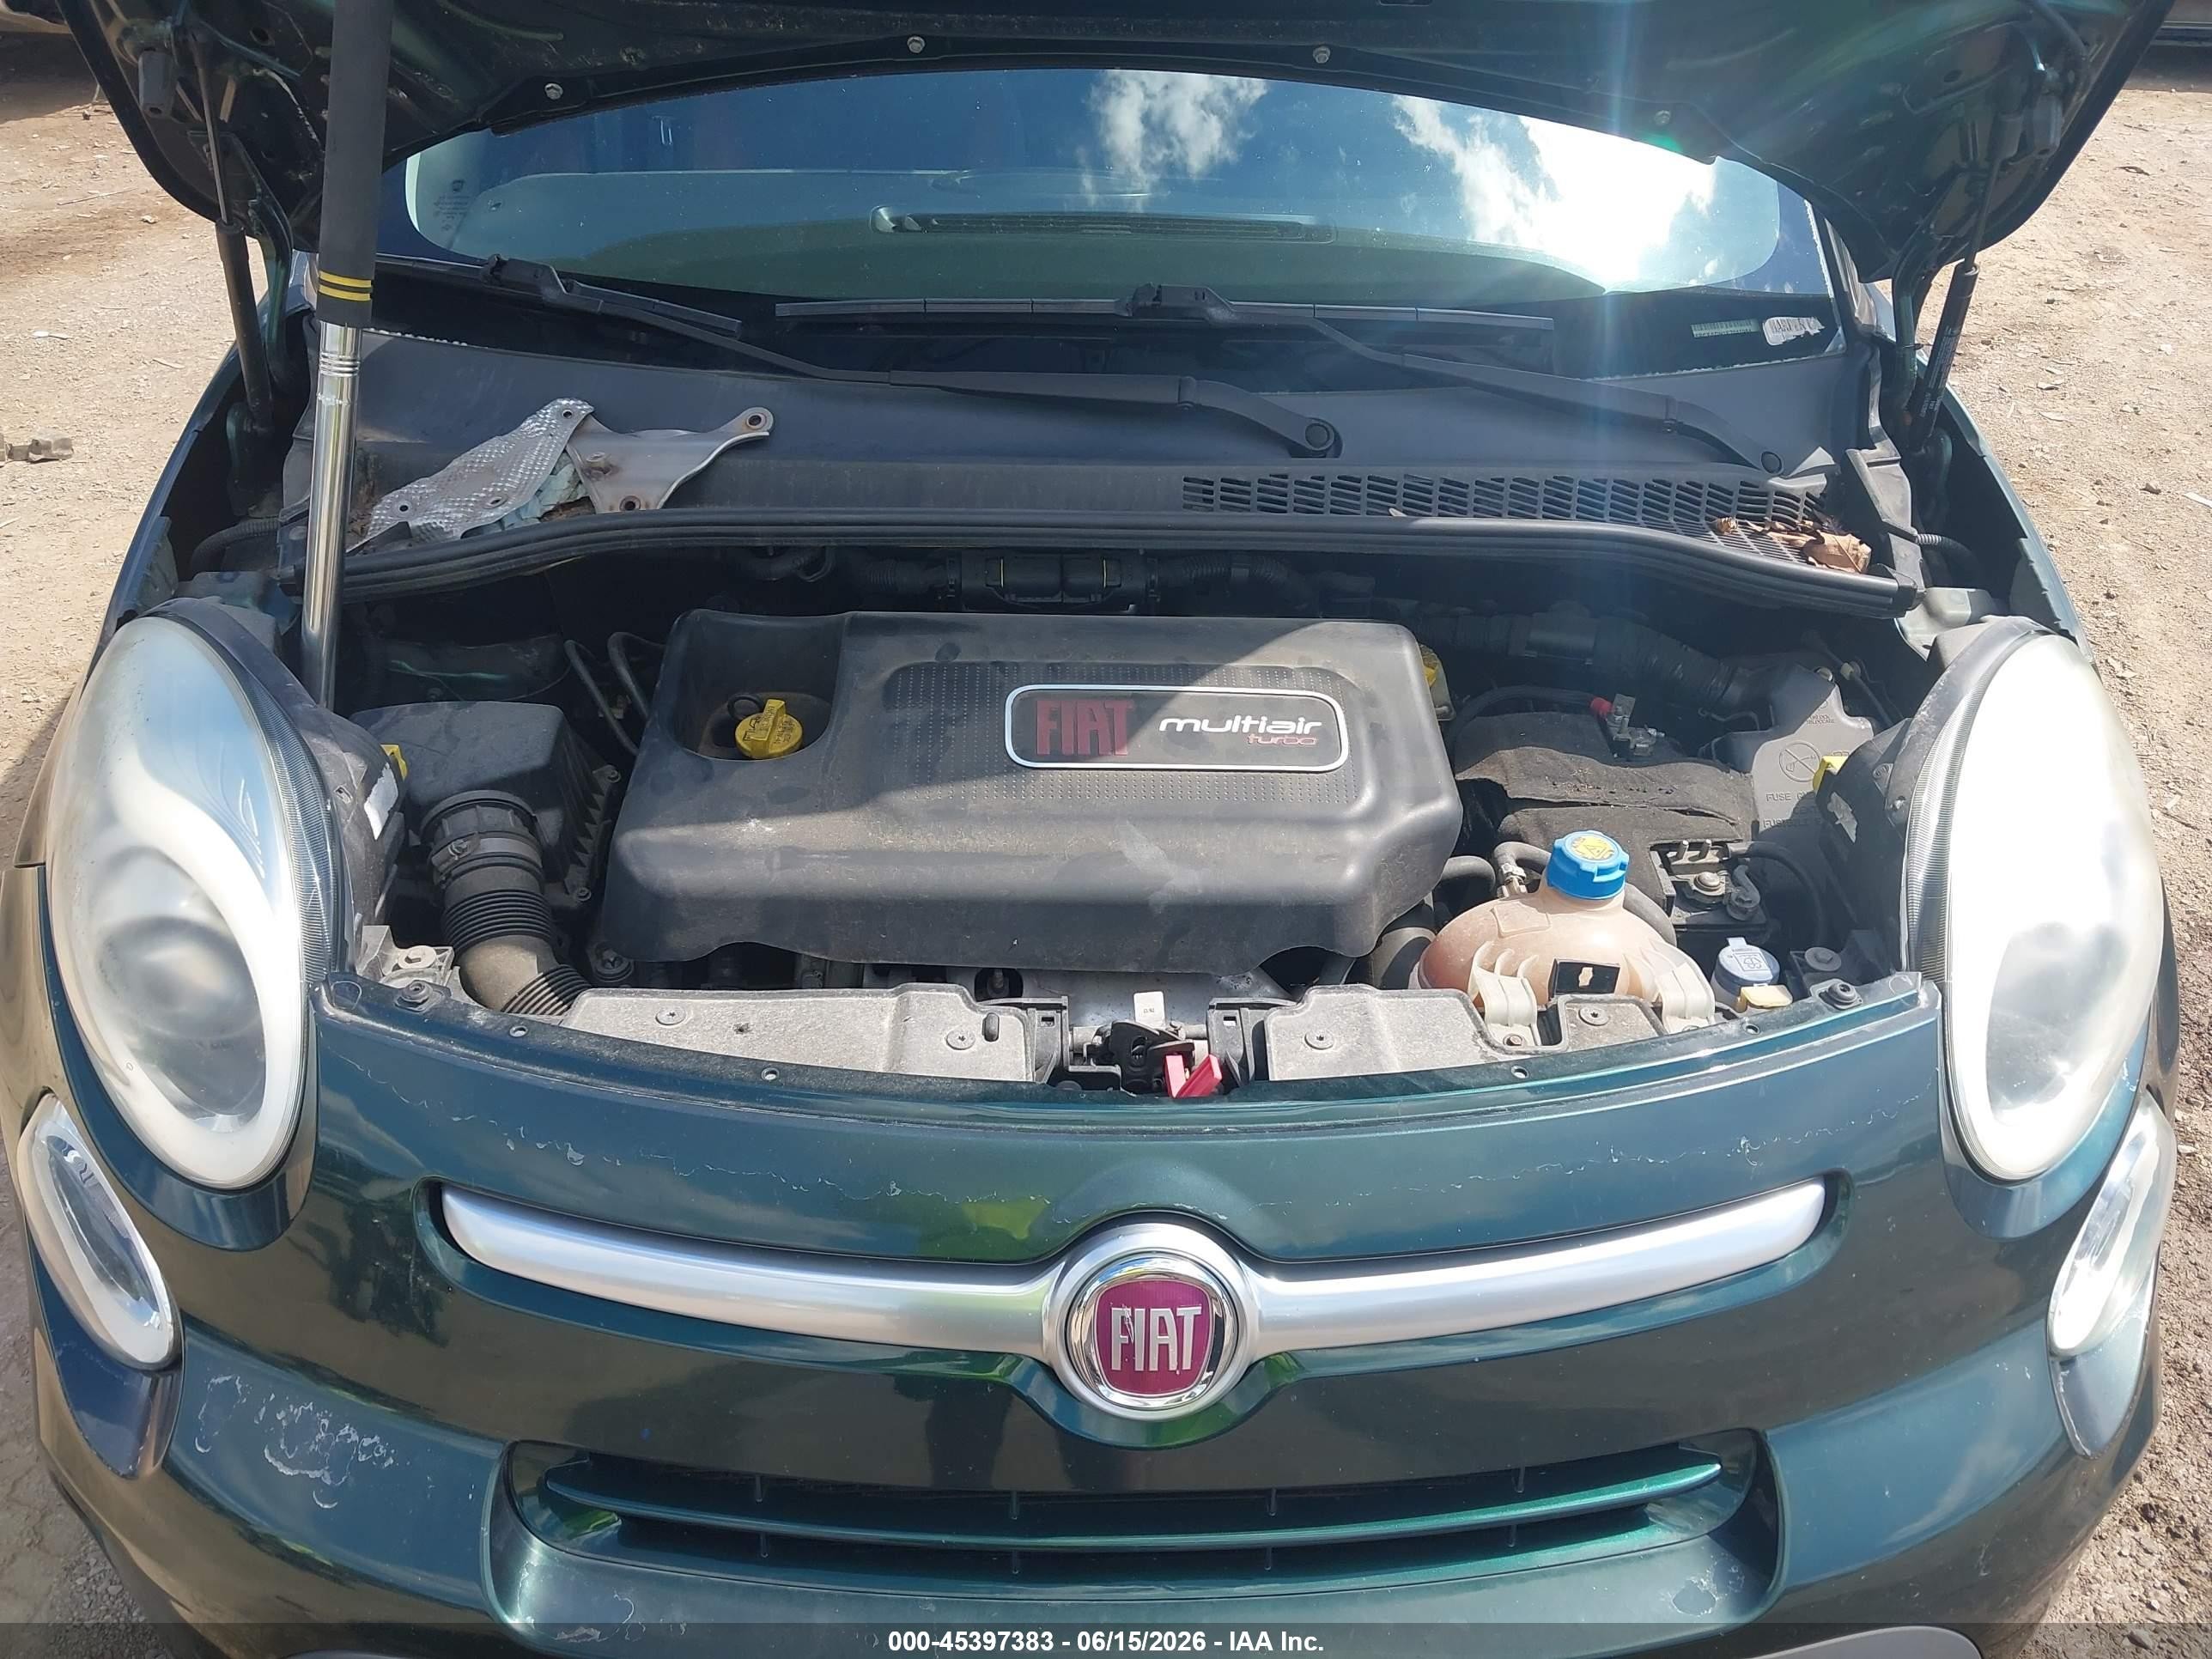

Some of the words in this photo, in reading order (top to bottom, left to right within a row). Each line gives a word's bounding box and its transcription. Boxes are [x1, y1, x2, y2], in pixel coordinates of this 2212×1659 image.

[1036, 700, 1134, 757] FIAT
[1158, 715, 1322, 735] multiair
[1247, 733, 1318, 747] turbo
[1109, 1305, 1202, 1371] FIAT
